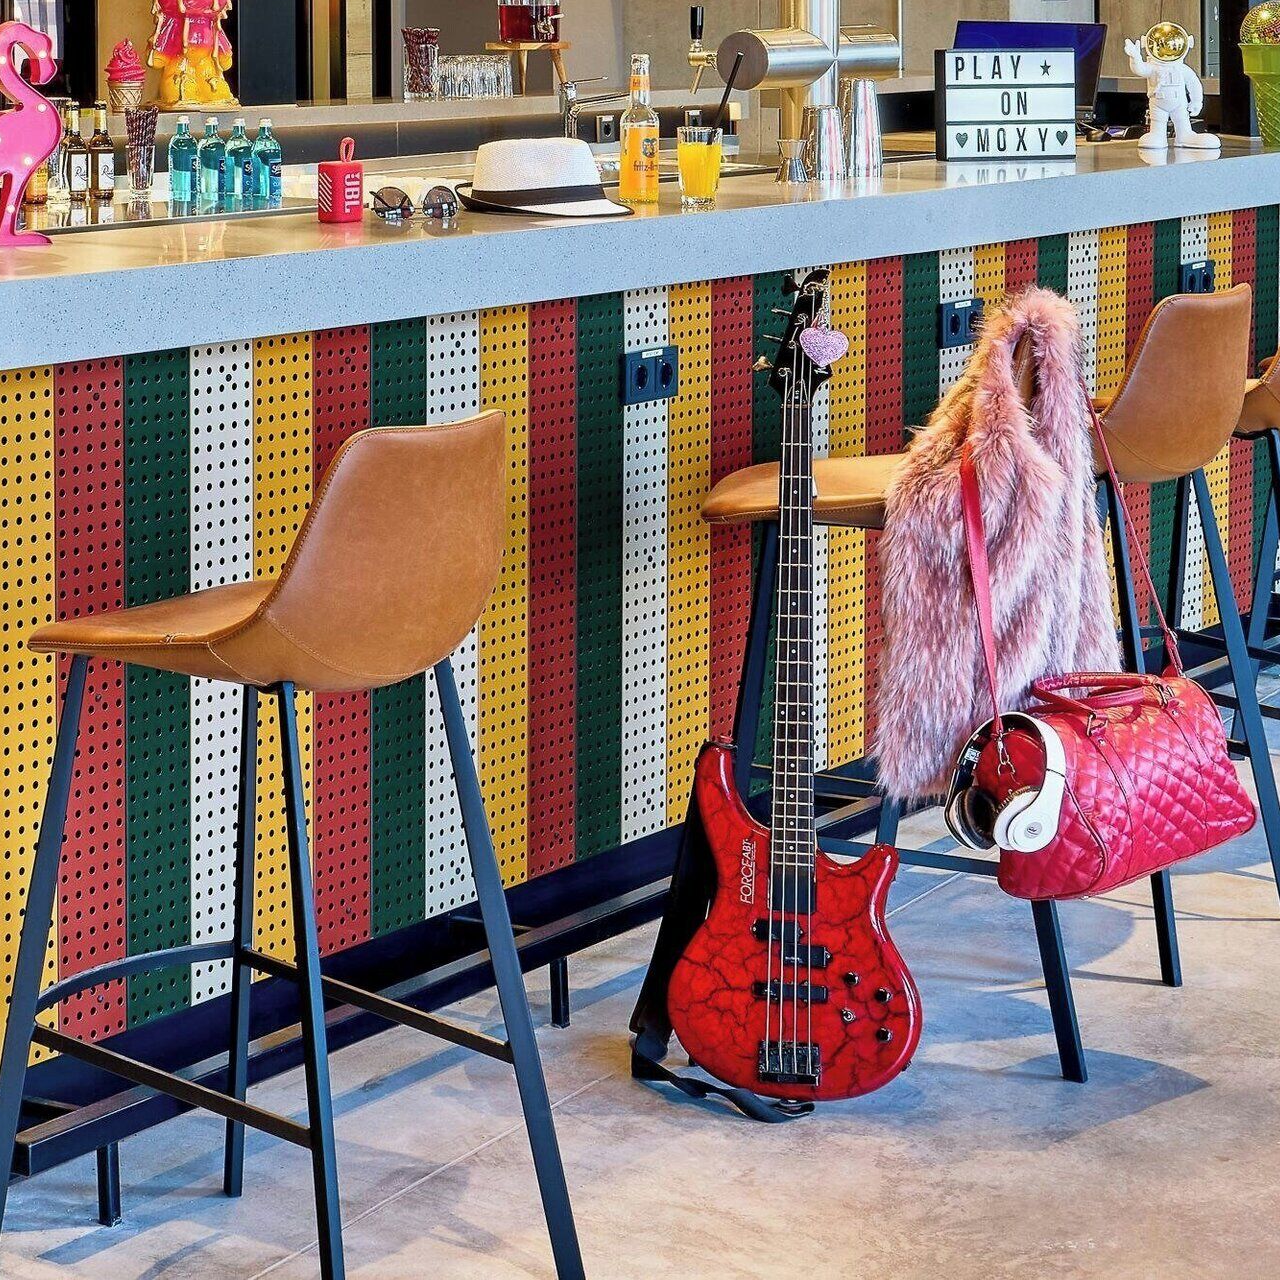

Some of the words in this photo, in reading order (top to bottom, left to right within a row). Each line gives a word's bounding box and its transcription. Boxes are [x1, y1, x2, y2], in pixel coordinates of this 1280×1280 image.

[954, 55, 1022, 81] PLAY
[1000, 90, 1028, 116] ON
[976, 126, 1048, 153] MOXY
